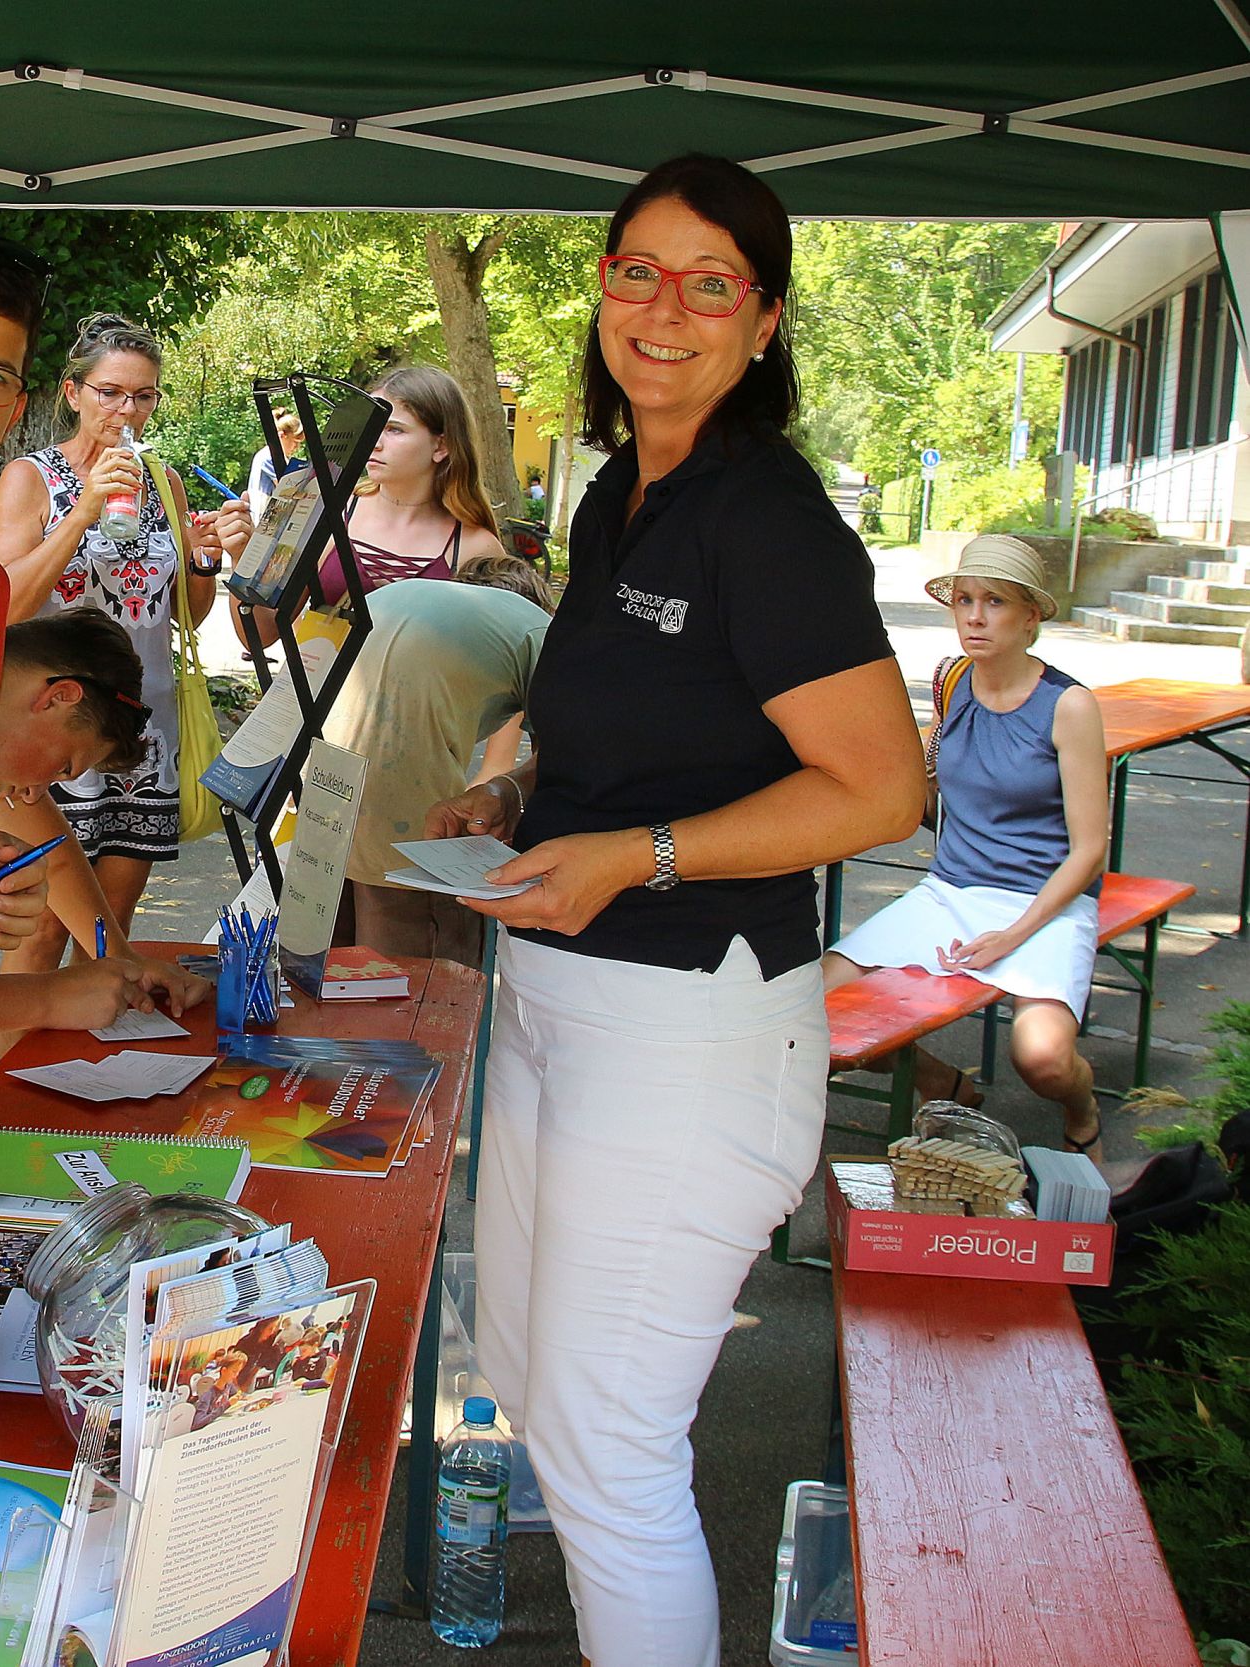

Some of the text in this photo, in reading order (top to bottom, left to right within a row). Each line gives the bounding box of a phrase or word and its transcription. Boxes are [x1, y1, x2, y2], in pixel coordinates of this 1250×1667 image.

[616, 583, 665, 608] ZINZENDORF
[622, 600, 661, 623] SCHULEN
[63, 1152, 85, 1171] Zur
[928, 1234, 1037, 1265] Pioneer
[1071, 1238, 1091, 1249] A4
[181, 1426, 272, 1459] Zinzendorfschulen bietet
[183, 1421, 263, 1450] Das Tagesinternat der
